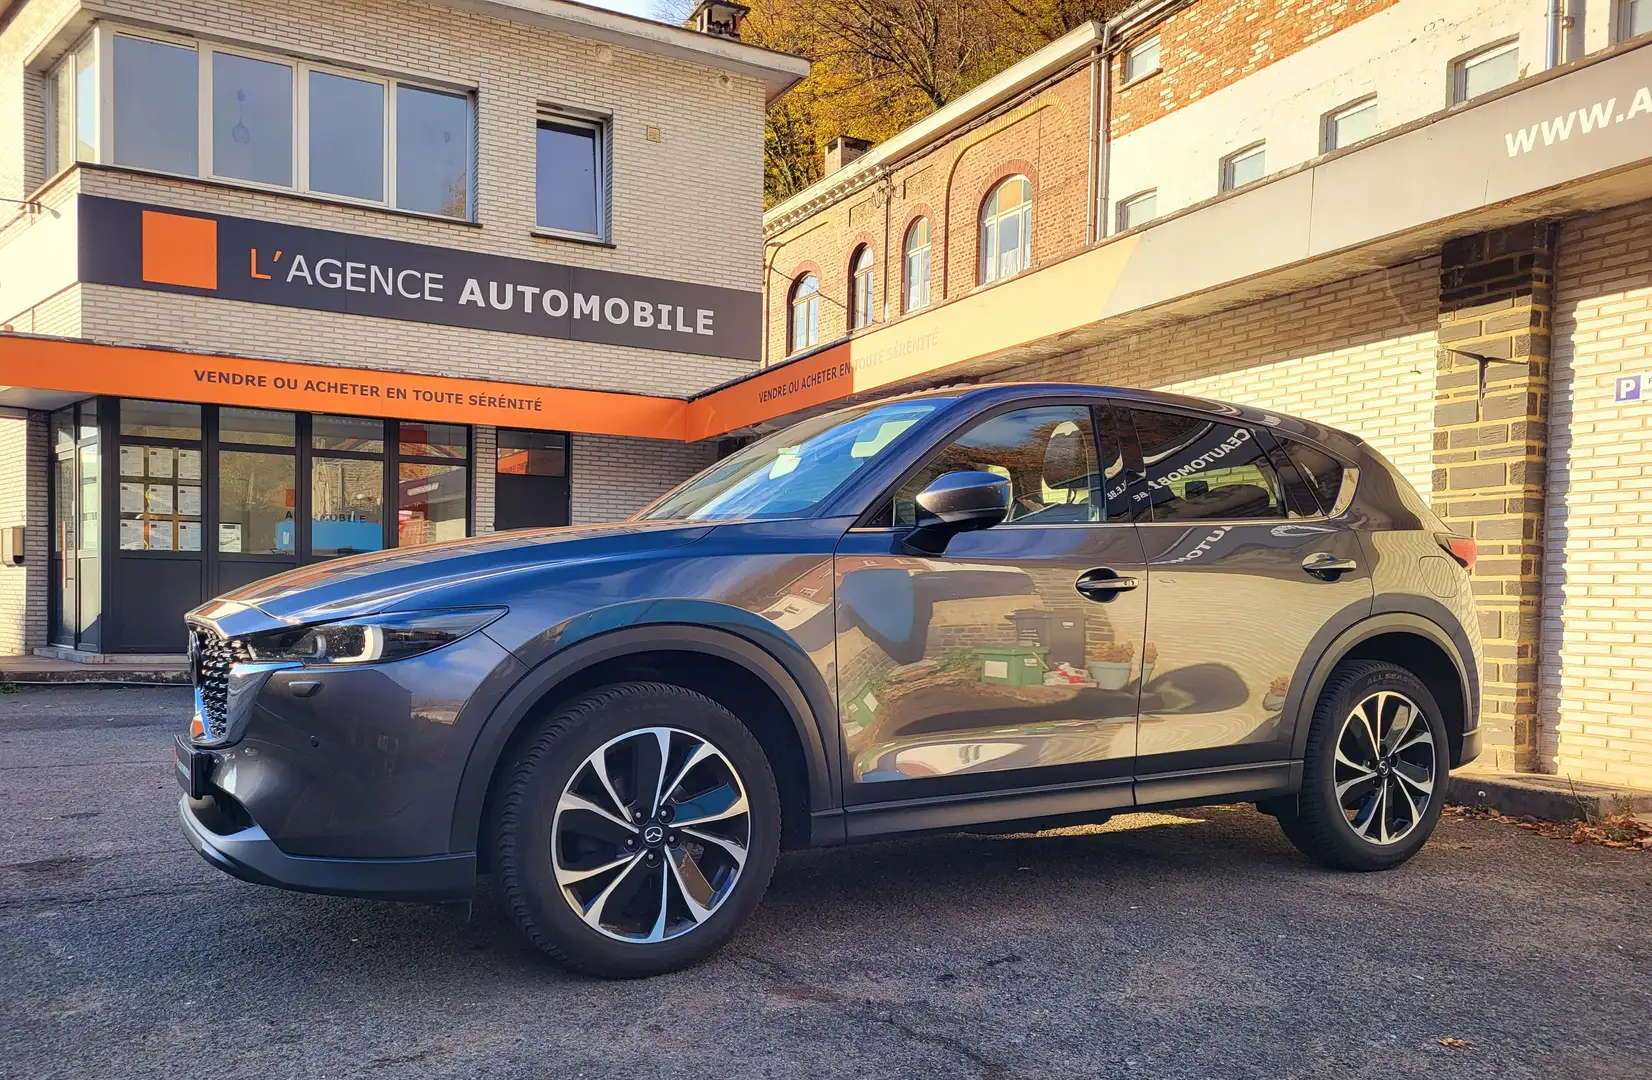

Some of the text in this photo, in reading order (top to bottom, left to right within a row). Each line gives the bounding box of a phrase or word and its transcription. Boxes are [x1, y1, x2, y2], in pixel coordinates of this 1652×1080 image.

[458, 278, 715, 336] AUTOMOBILE
[194, 369, 543, 411] VENDRE OU ACHETER EN TOUTE SÉRÉNITÉ
[758, 384, 787, 404] VENDRE
[788, 379, 800, 394] OU
[801, 366, 837, 390] ACHETER
[839, 361, 851, 377] EN
[854, 348, 885, 373] TOUTE
